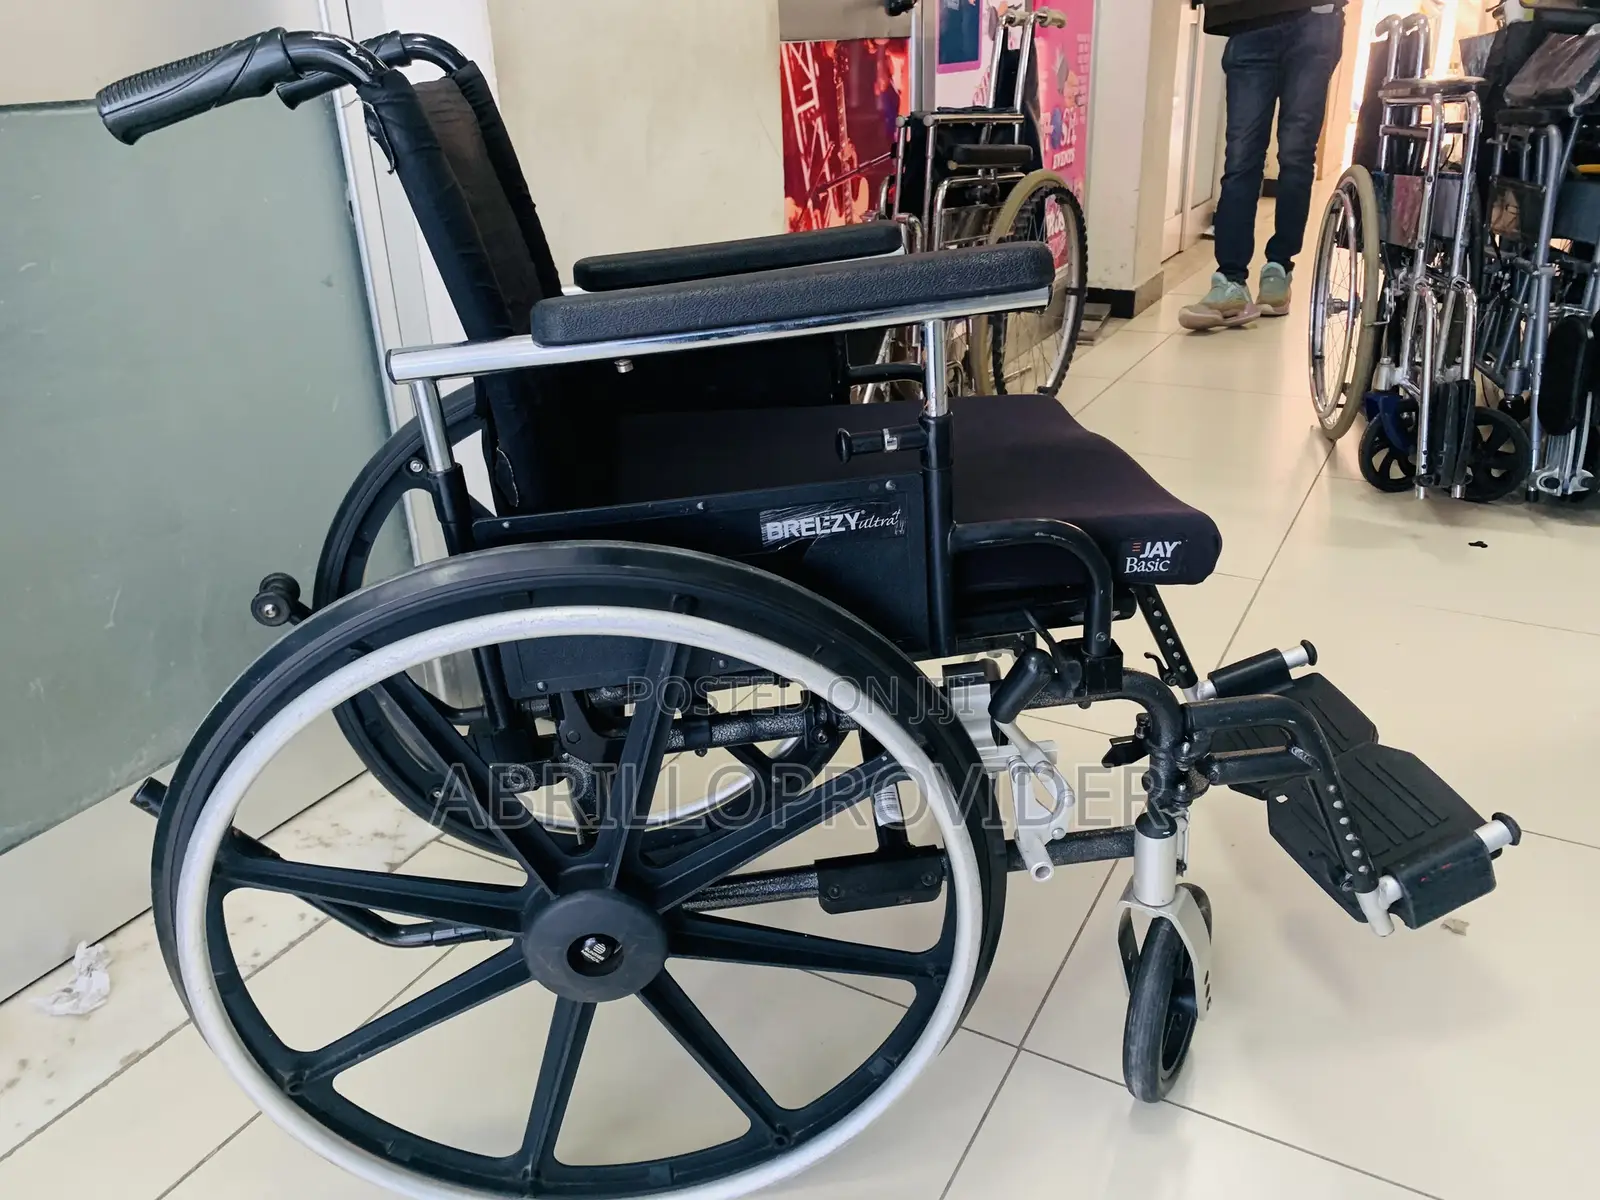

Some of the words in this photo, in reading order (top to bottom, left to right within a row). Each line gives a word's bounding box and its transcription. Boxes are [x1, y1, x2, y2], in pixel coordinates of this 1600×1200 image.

[766, 511, 861, 541] BREEZY
[1139, 541, 1179, 559] JAY
[1124, 556, 1171, 574] Basic
